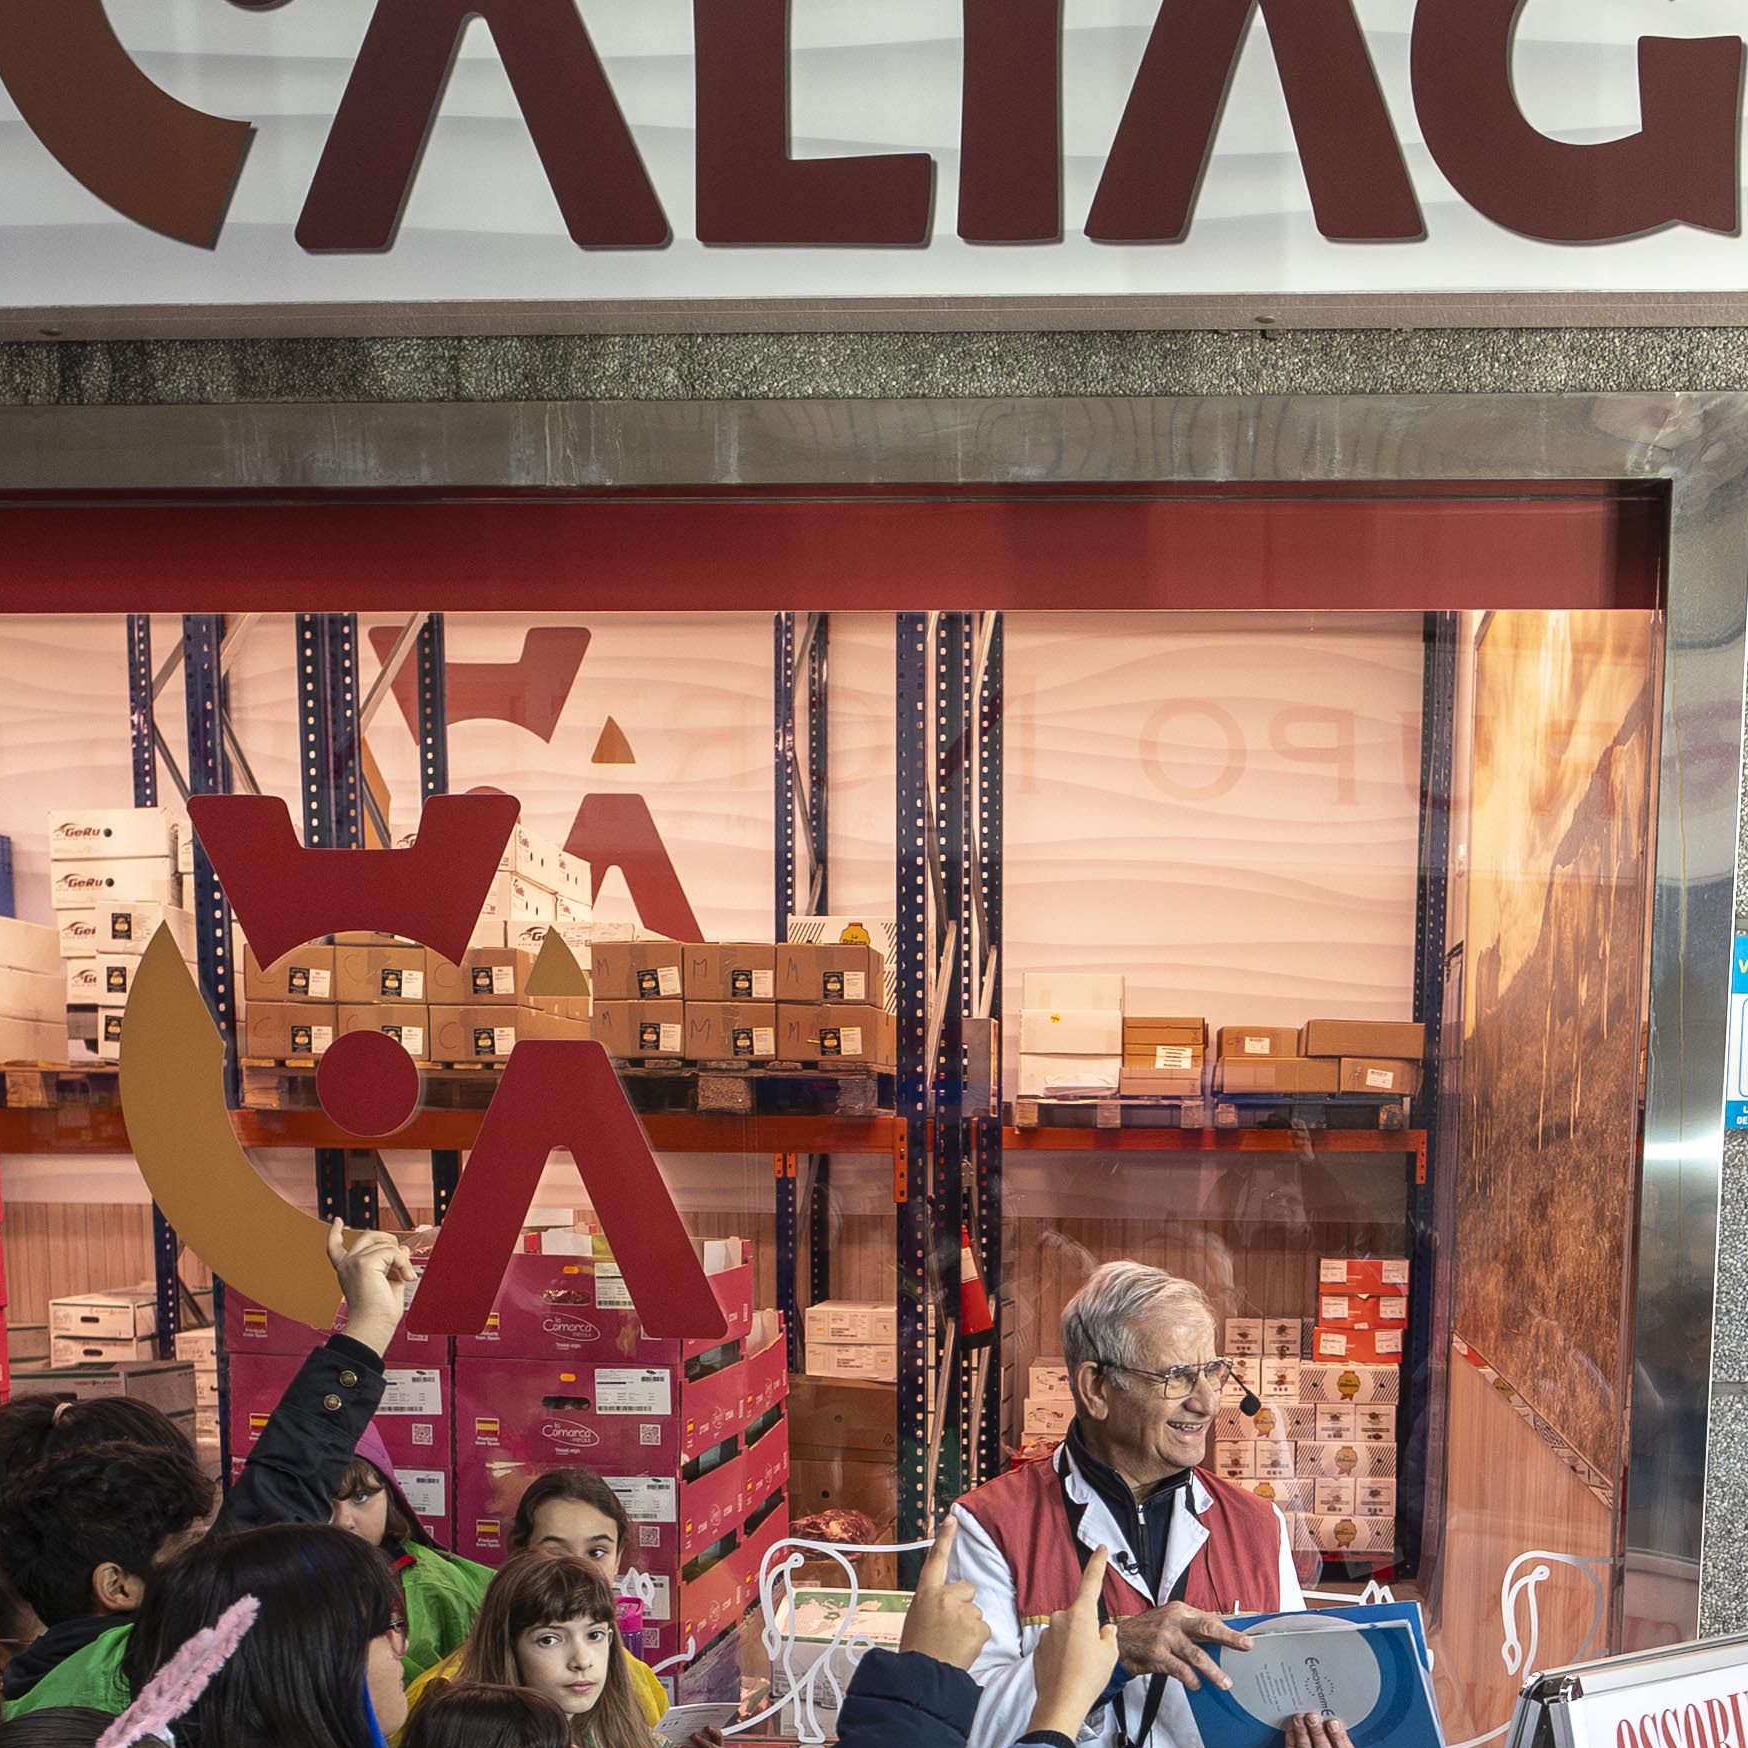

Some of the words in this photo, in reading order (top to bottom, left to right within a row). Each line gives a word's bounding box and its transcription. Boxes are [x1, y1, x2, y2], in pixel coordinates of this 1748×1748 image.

[1737, 1116, 1748, 1125] DE
[543, 1319, 592, 1333] Comarca
[542, 1425, 592, 1439] Comarca
